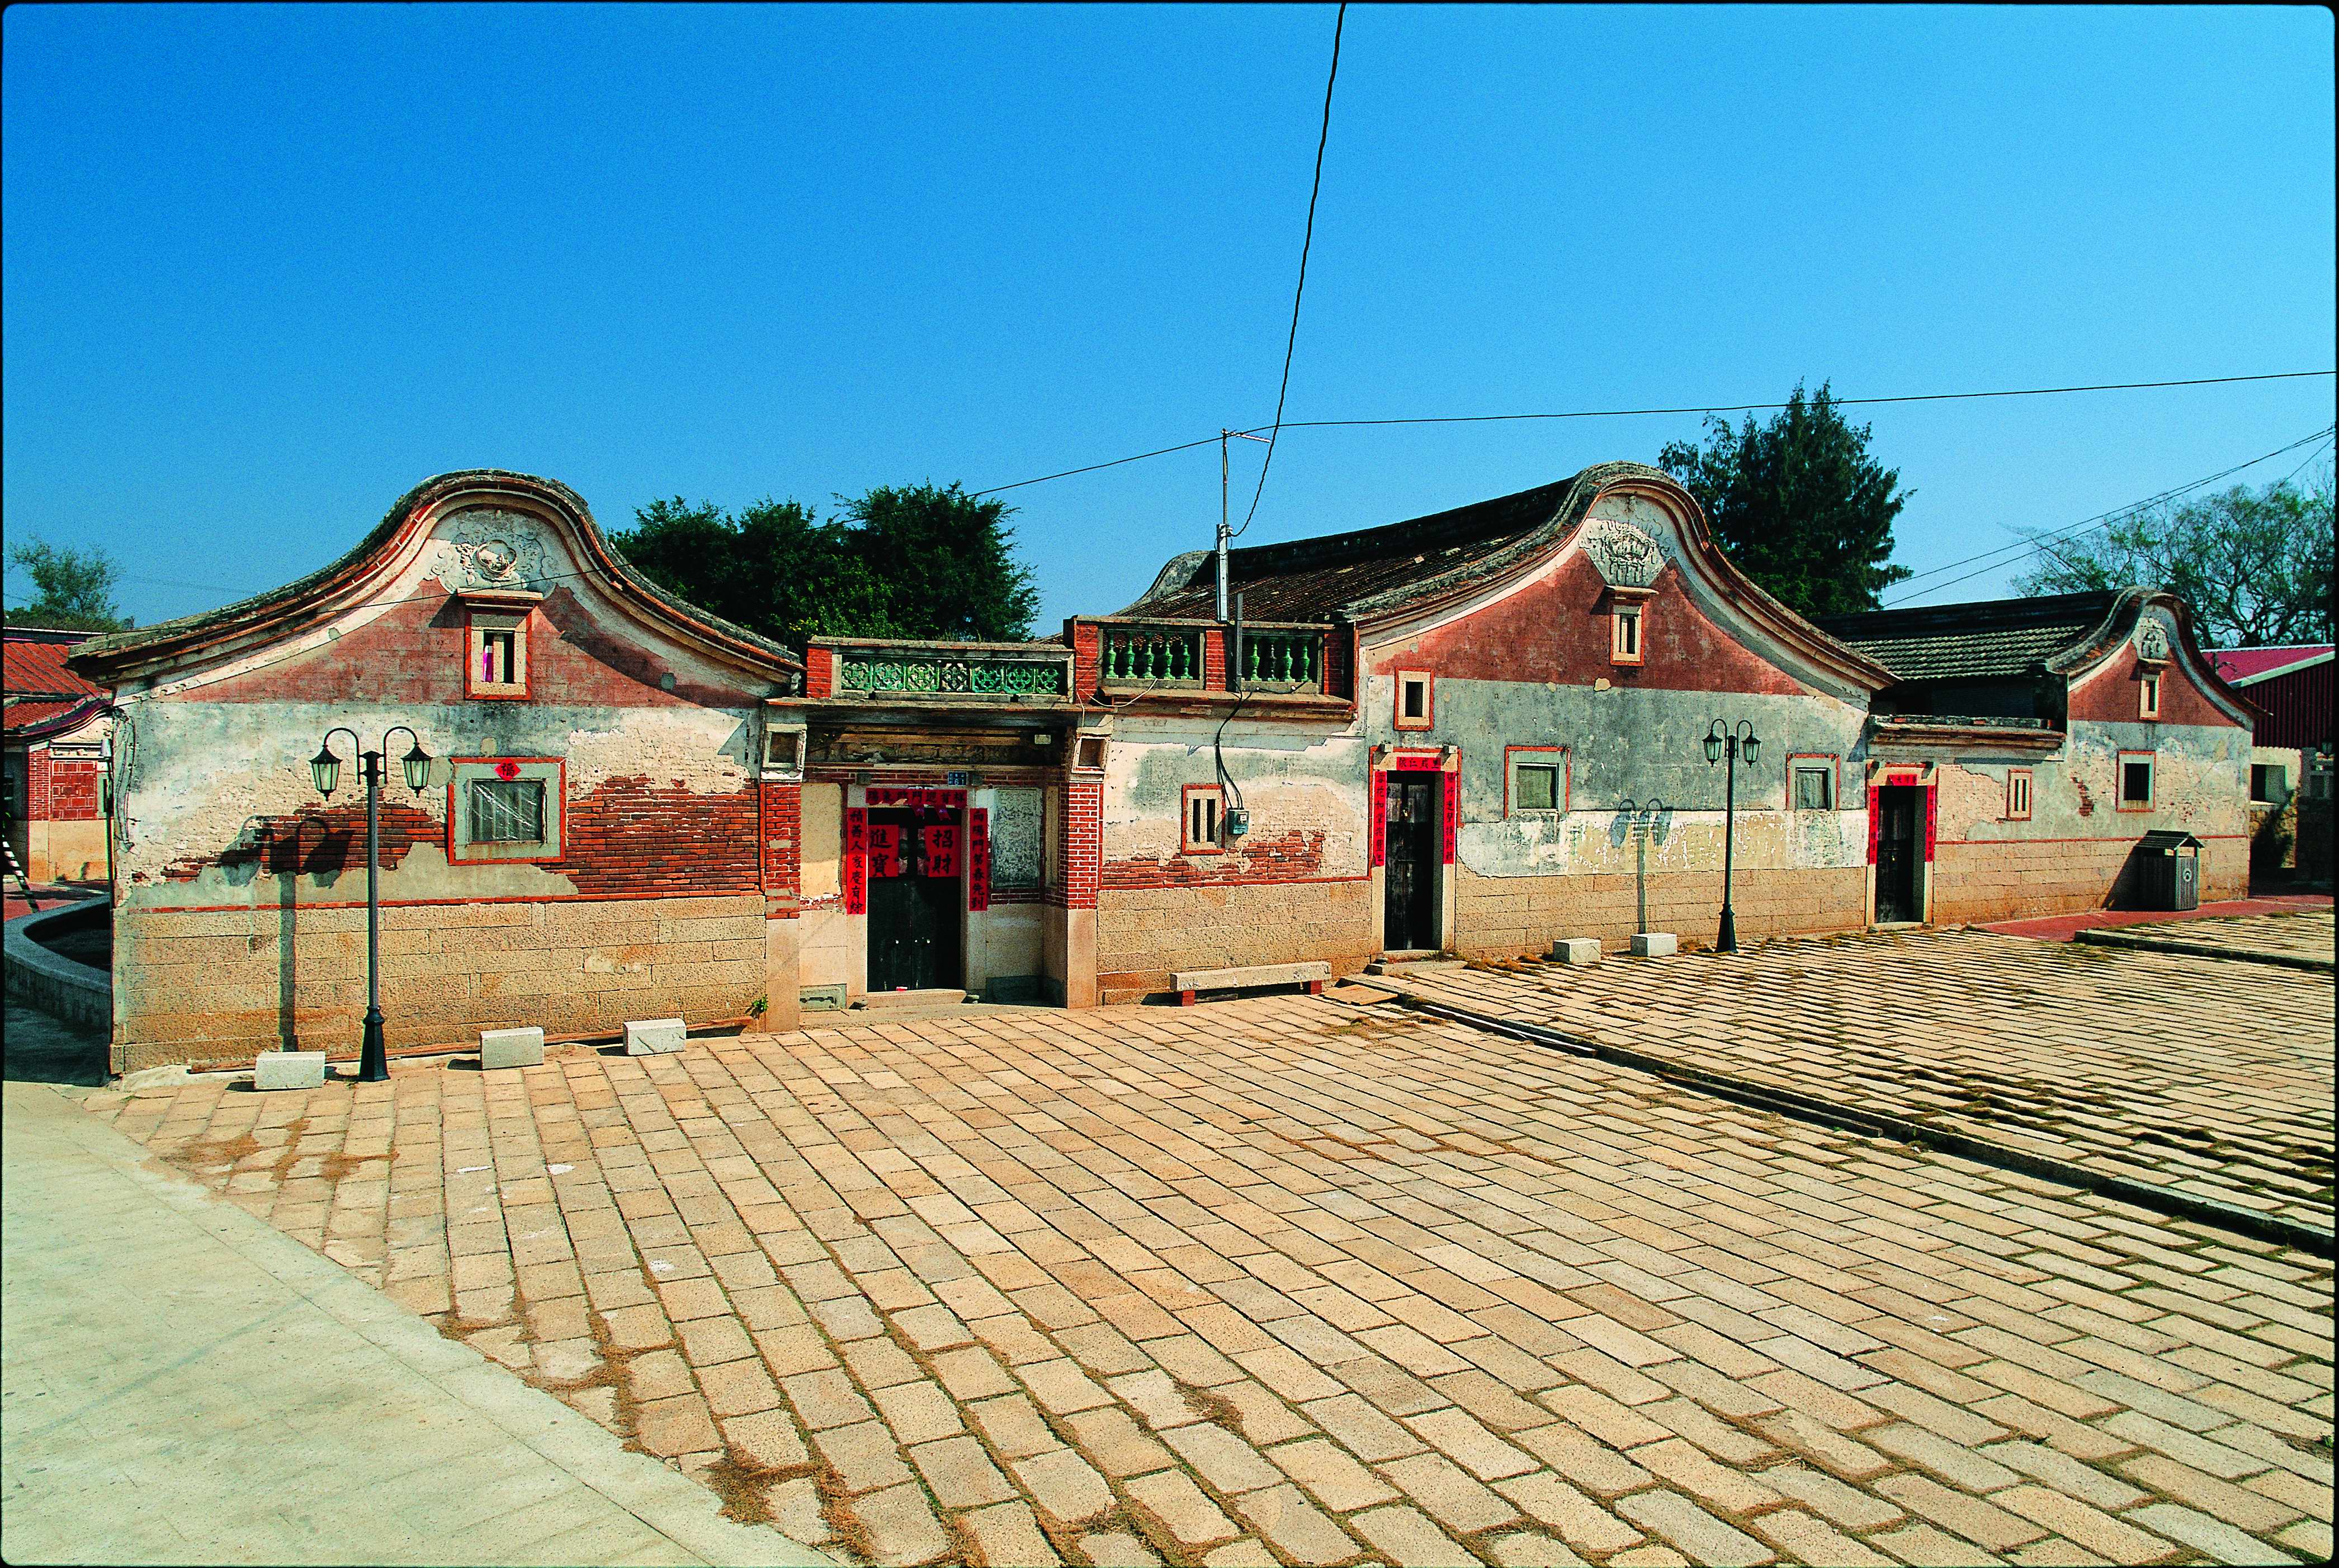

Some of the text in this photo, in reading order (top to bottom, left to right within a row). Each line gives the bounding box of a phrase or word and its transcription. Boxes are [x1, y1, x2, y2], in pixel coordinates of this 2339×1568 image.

[501, 763, 514, 776] 福
[869, 828, 892, 877] 進寶
[932, 829, 953, 874] 招財
